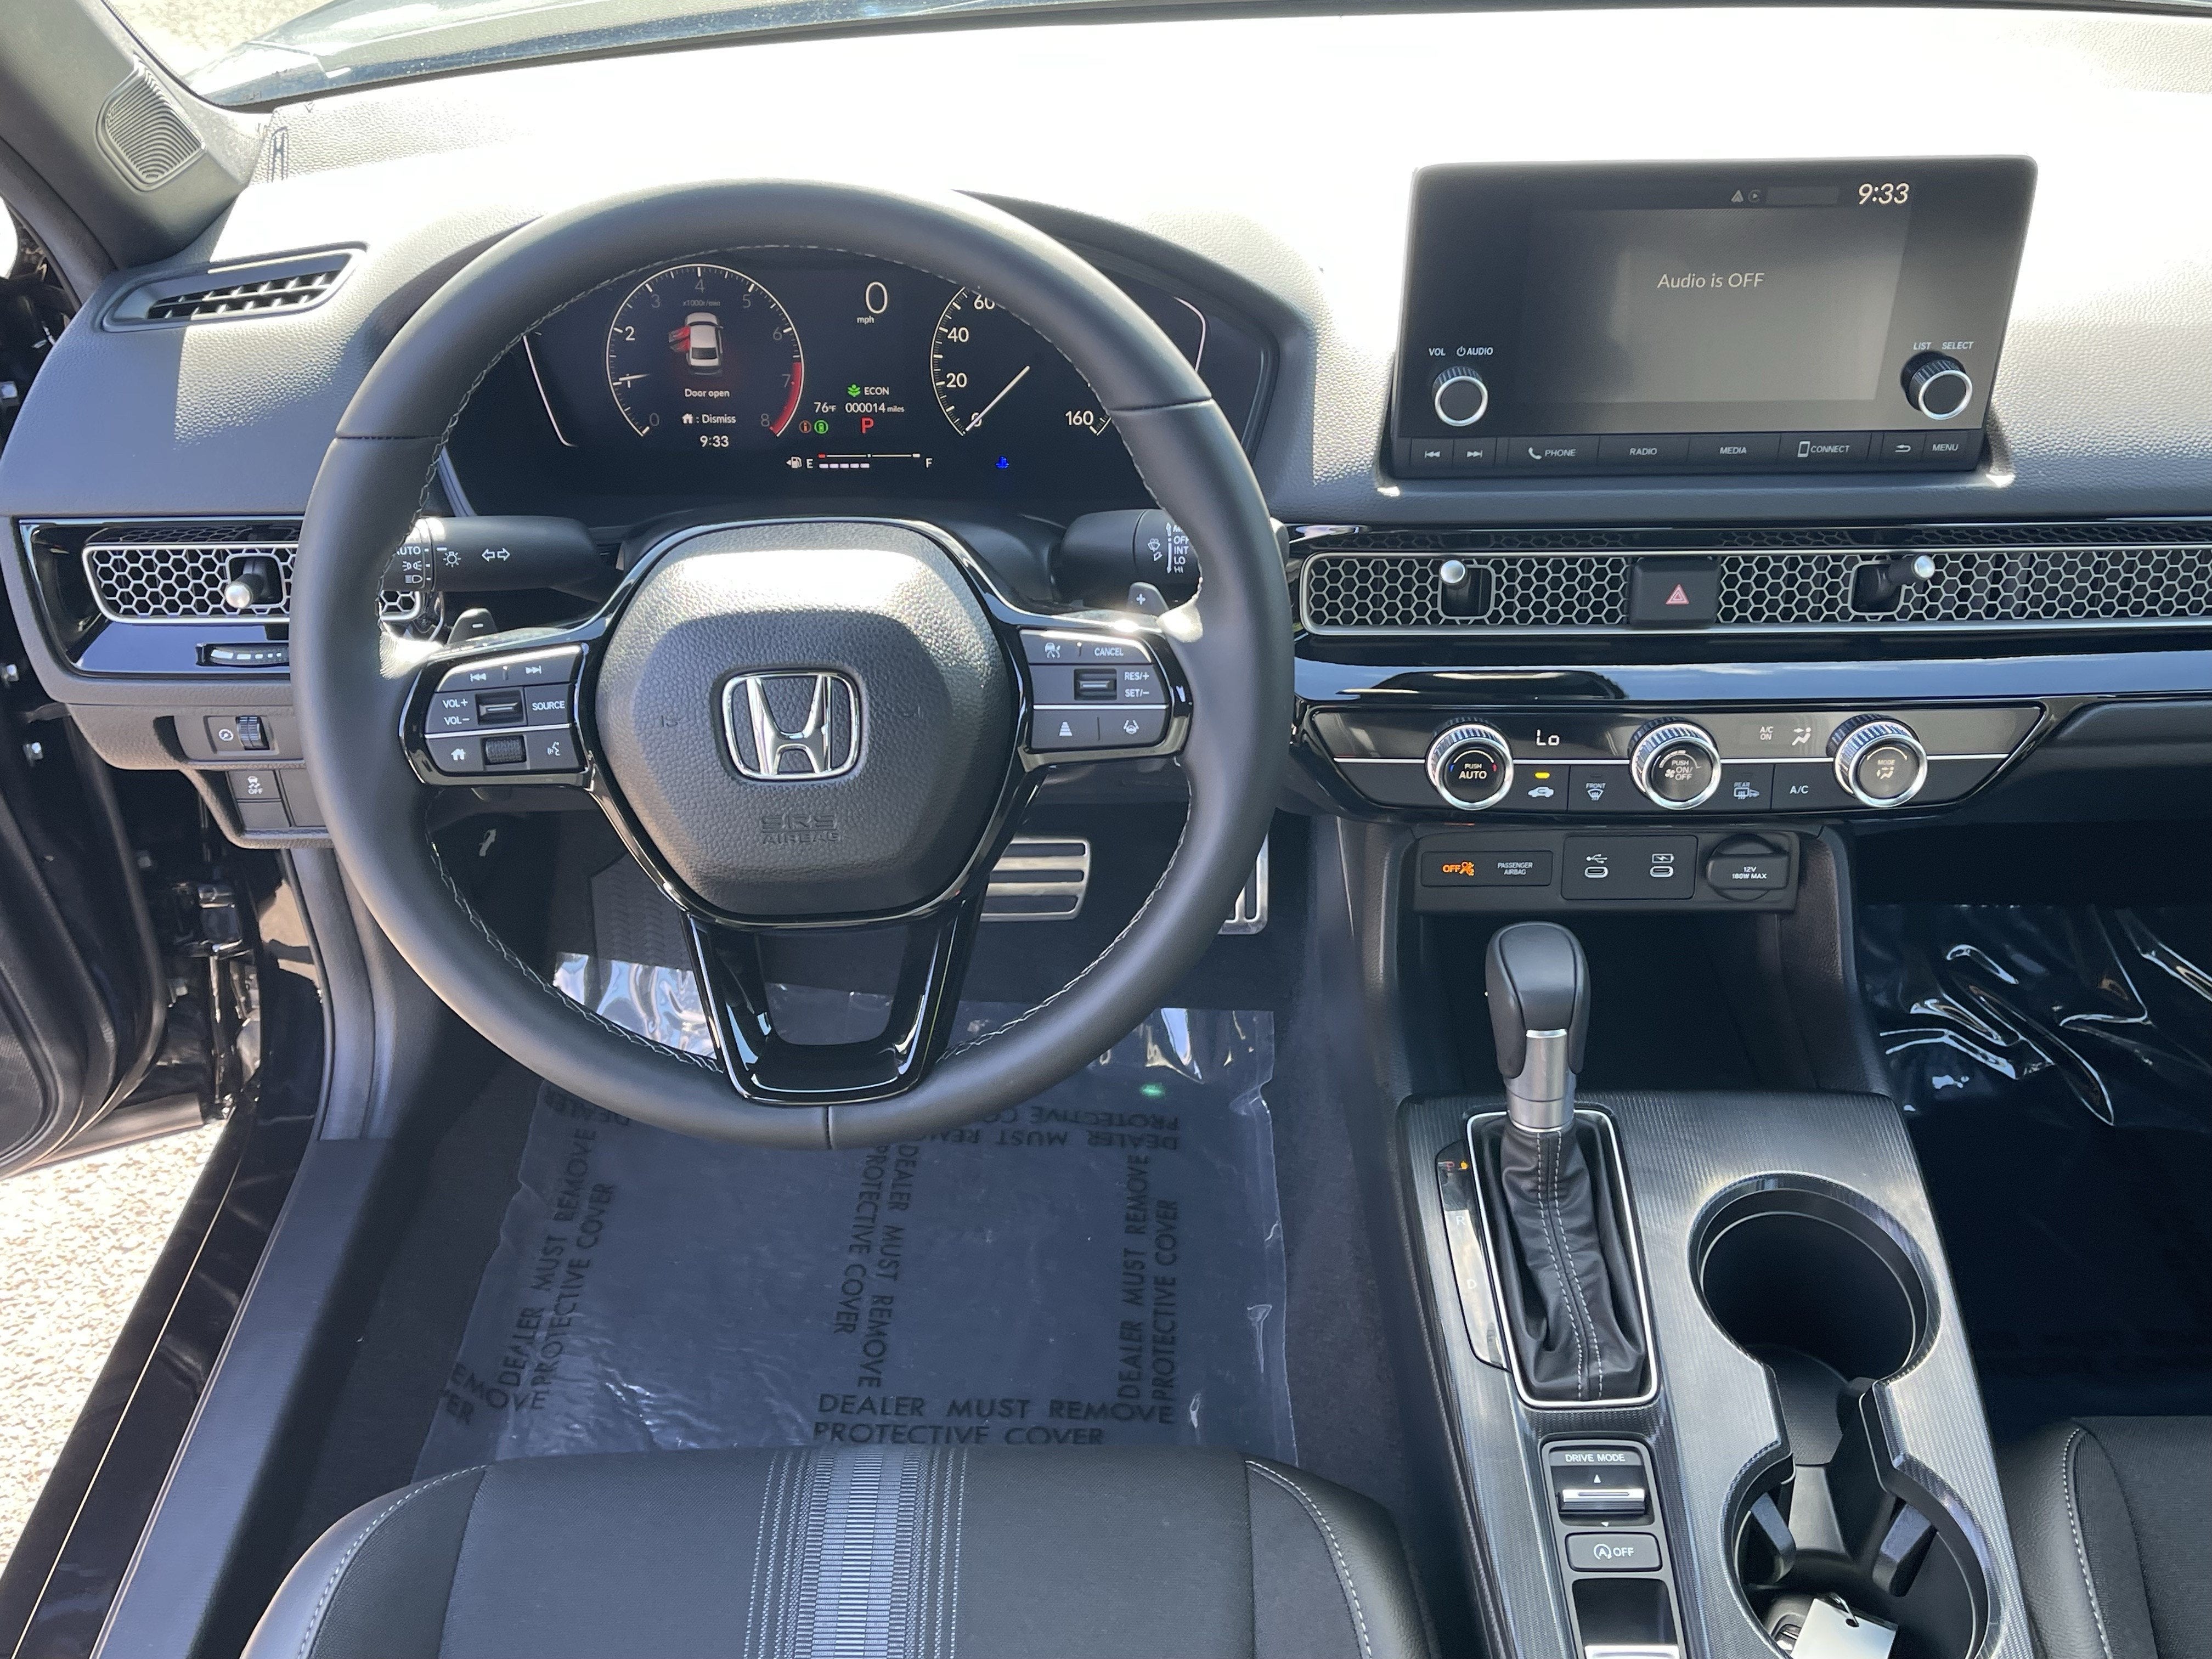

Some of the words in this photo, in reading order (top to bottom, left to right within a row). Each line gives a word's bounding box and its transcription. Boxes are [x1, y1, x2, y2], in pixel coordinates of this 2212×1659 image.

[1858, 183, 1909, 204] 9:33
[695, 279, 704, 292] 4
[1657, 274, 1705, 289] Audio
[1711, 274, 1723, 288] is
[1728, 273, 1764, 287] OFF
[651, 295, 661, 308] 3
[743, 294, 751, 308] 5
[865, 281, 888, 314] 0
[974, 294, 995, 309] 60
[857, 316, 874, 324] mph
[625, 326, 635, 341] 2
[773, 326, 782, 340] 6
[947, 327, 969, 342] 40
[1429, 347, 1446, 356] VOL
[1467, 347, 1493, 356] AUDIO
[1942, 341, 1974, 349] SELECT
[782, 374, 791, 387] 7
[946, 373, 967, 388] 20
[685, 389, 706, 397] Door
[708, 390, 730, 398] open
[864, 387, 889, 395] ECON
[845, 402, 886, 413] 000014
[650, 413, 659, 426] 0
[702, 415, 736, 424] Dismiss
[760, 414, 770, 427] 8
[1065, 410, 1093, 425] 160
[860, 416, 874, 434] P
[699, 436, 729, 448] 9:33
[1545, 449, 1576, 457] PHONE
[1720, 446, 1747, 454] MEDIA
[1810, 445, 1849, 453] CONNECT
[806, 459, 813, 468] E
[926, 458, 933, 468] F
[1174, 546, 1189, 555] INT
[1174, 556, 1186, 565] LO
[1094, 647, 1124, 656] CANCEL
[1124, 672, 1149, 680] RES/+
[532, 701, 565, 710] SOURCE
[1459, 771, 1487, 779] AUTO
[1790, 786, 1809, 794] A/C
[1442, 864, 1461, 873] OFF
[996, 1128, 1069, 1147] MUST
[888, 1145, 919, 1211] DEALER
[848, 1145, 889, 1255] PROTECTIVE
[1125, 1154, 1149, 1234] REMOVE
[1455, 1216, 1466, 1225] R
[1155, 1199, 1178, 1266] COVER
[878, 1225, 905, 1282] MUST
[1122, 1248, 1146, 1307] MUST
[1466, 1279, 1477, 1289] D
[531, 1258, 591, 1387] PROTECTIVE
[576, 1183, 616, 1250] COVER
[833, 1263, 867, 1335] COVER
[498, 1307, 545, 1387] DEALER
[531, 1235, 569, 1291] MUST
[857, 1294, 894, 1388] REMOVE
[1152, 1276, 1177, 1401] PROTECTIVE
[1117, 1320, 1144, 1400] DEALER
[817, 1393, 925, 1417] DEALER
[945, 1398, 1030, 1419] MUST
[1049, 1399, 1177, 1424] REMOVE
[812, 1421, 990, 1444] PROTECTIVE
[1005, 1427, 1104, 1444] COVER
[1565, 1454, 1594, 1463] DRIVE
[1597, 1454, 1625, 1462] MODE
[1613, 1547, 1634, 1557] OFF
